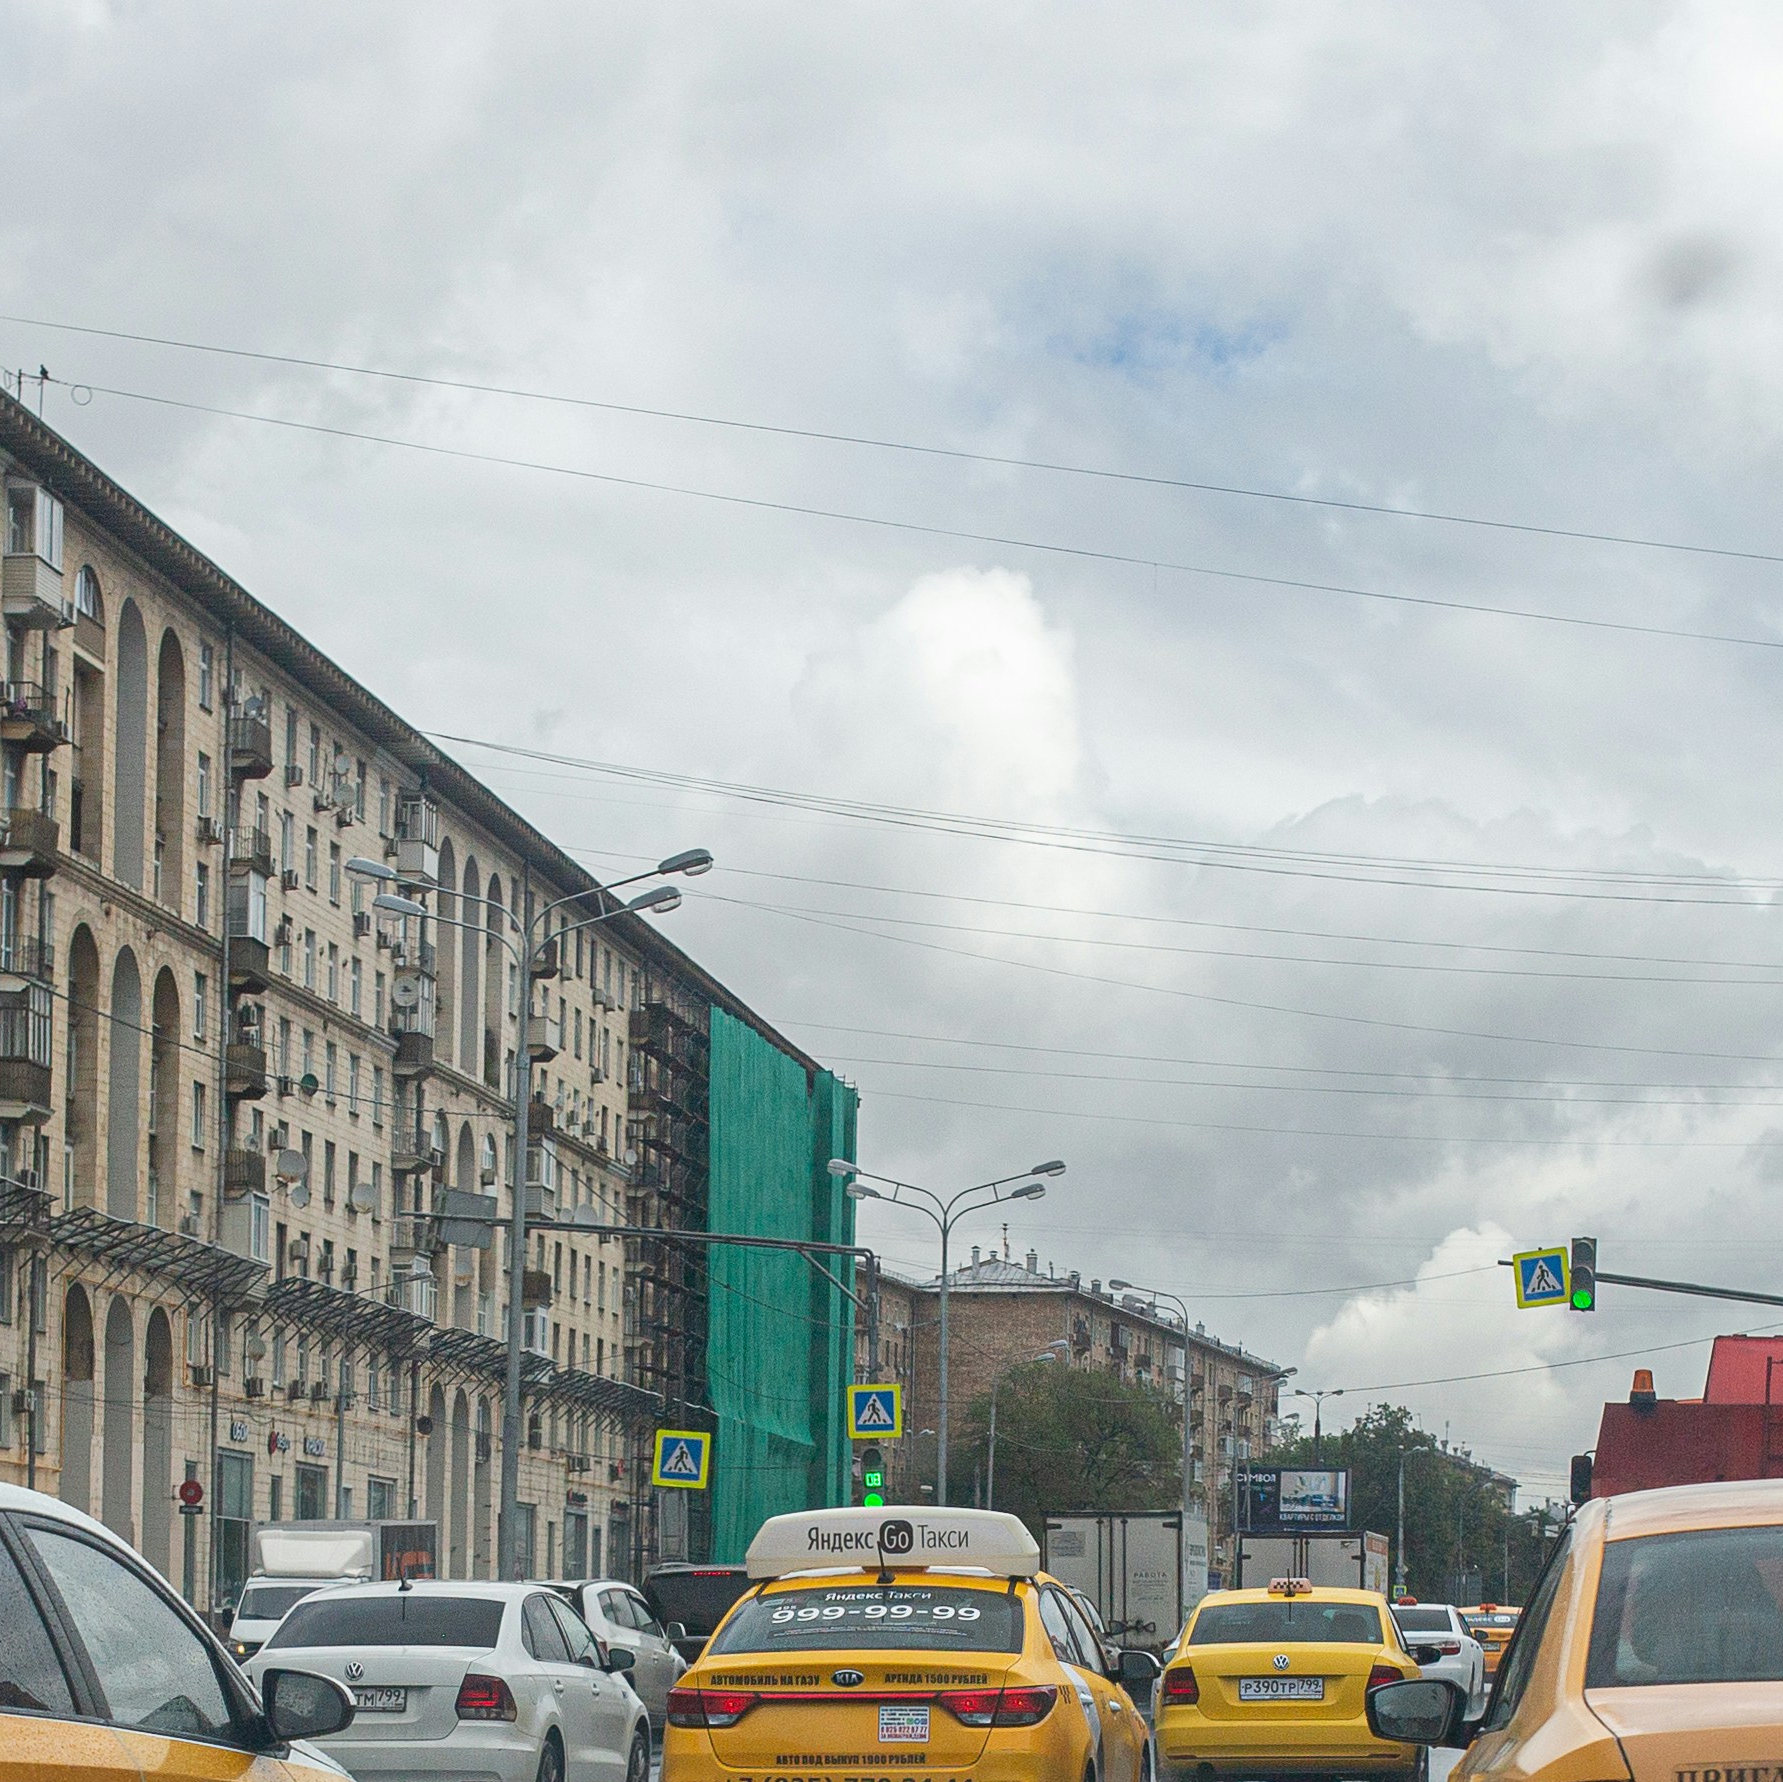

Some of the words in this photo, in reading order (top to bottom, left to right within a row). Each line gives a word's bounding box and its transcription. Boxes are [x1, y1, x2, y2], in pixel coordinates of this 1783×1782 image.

[807, 1526, 874, 1553] Яндекс
[883, 1524, 910, 1550] Go
[917, 1524, 969, 1549] Такси
[824, 1592, 883, 1601] Яндекс
[887, 1590, 932, 1600] Такси
[771, 1604, 982, 1624] 999-99-99
[710, 1675, 779, 1686] АВТОМОБИЛЬ
[780, 1675, 794, 1686] НА
[795, 1675, 821, 1686] ГАЗУ
[835, 1673, 861, 1683] KIA
[884, 1673, 923, 1685] АРЕНДА
[924, 1673, 950, 1684] 1500
[951, 1673, 988, 1685] РУБЛЕЙ
[1244, 1680, 1297, 1694] Р390ТР
[1299, 1679, 1320, 1690] 799
[376, 1688, 401, 1702] 799
[776, 1755, 800, 1766] АВТО
[801, 1755, 823, 1767] ПОД
[824, 1755, 860, 1766] ВЫКУП
[888, 1754, 926, 1765] РУБЛЕЙ
